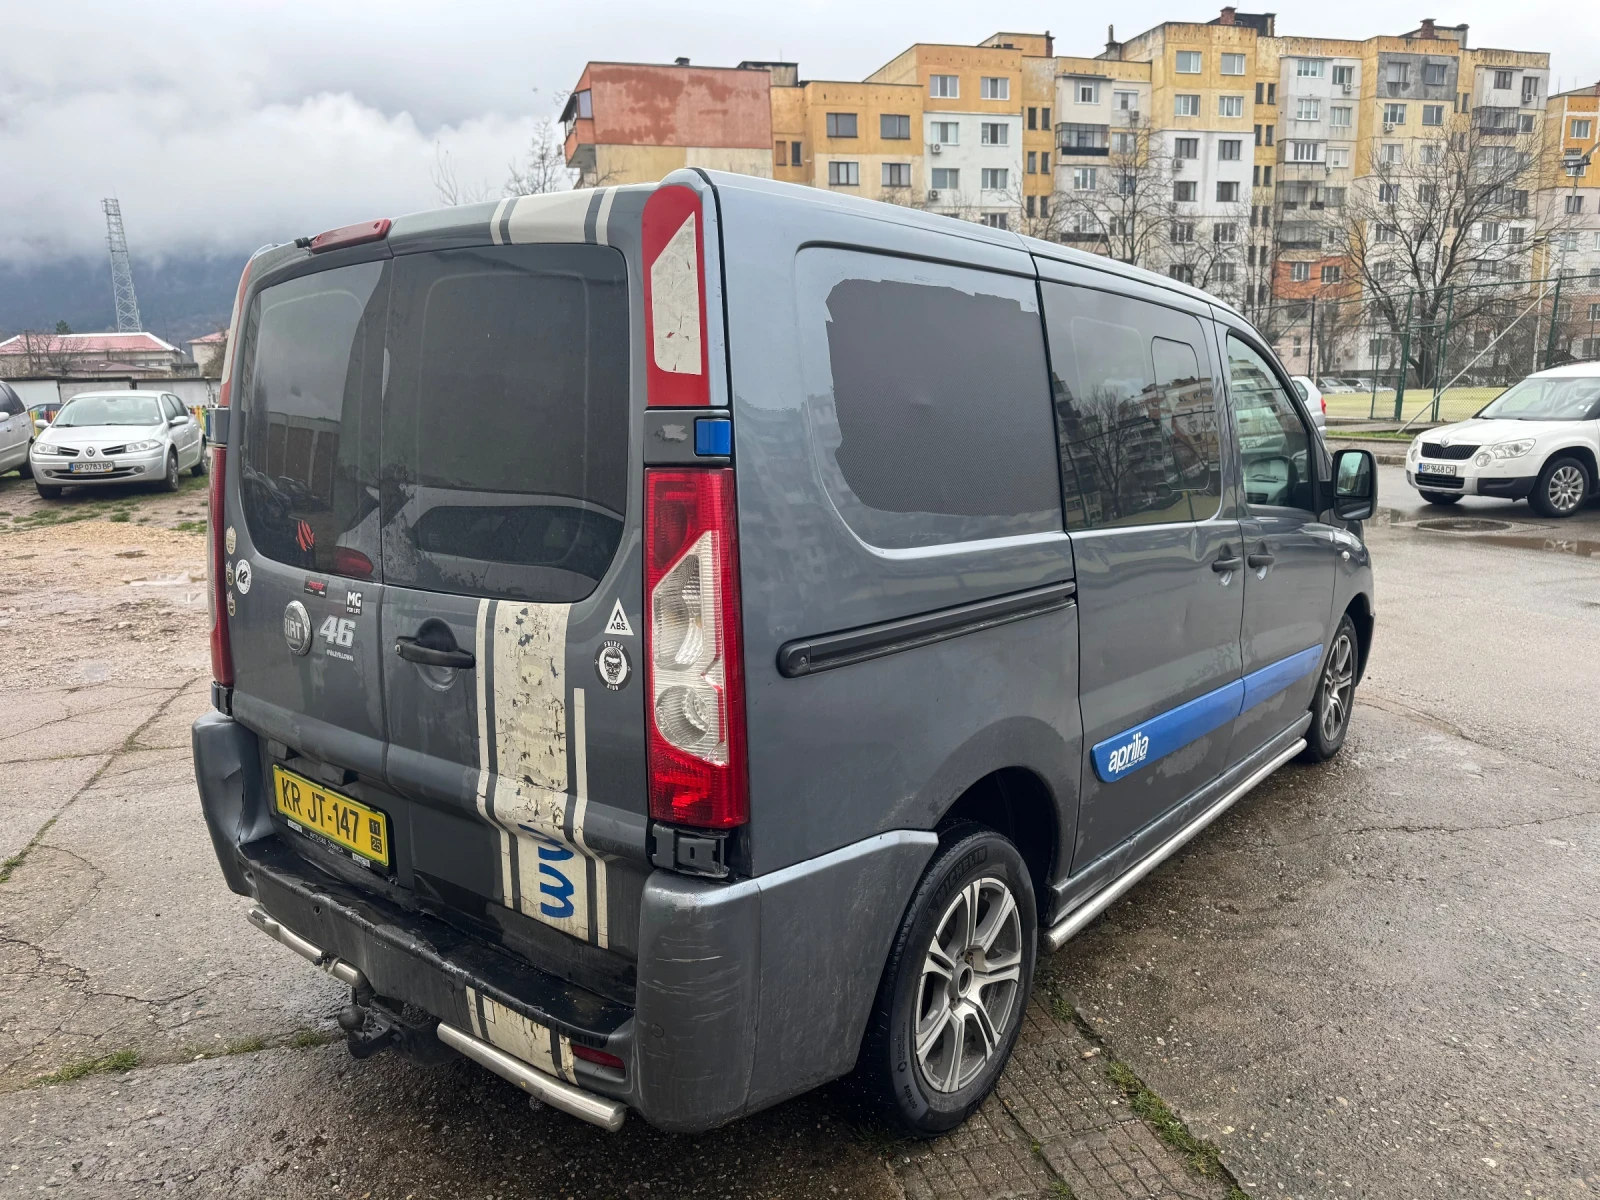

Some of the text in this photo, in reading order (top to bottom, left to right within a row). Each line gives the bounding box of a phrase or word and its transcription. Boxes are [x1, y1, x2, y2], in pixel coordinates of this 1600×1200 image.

[347, 591, 362, 607] MG
[285, 617, 302, 640] FIAT
[319, 615, 356, 648] 46
[1108, 731, 1149, 774] aprilia
[281, 777, 302, 816] KR
[307, 791, 359, 843] JT-147
[370, 820, 380, 836] 11
[371, 837, 381, 852] 25
[935, 848, 987, 908] MICHELIN
